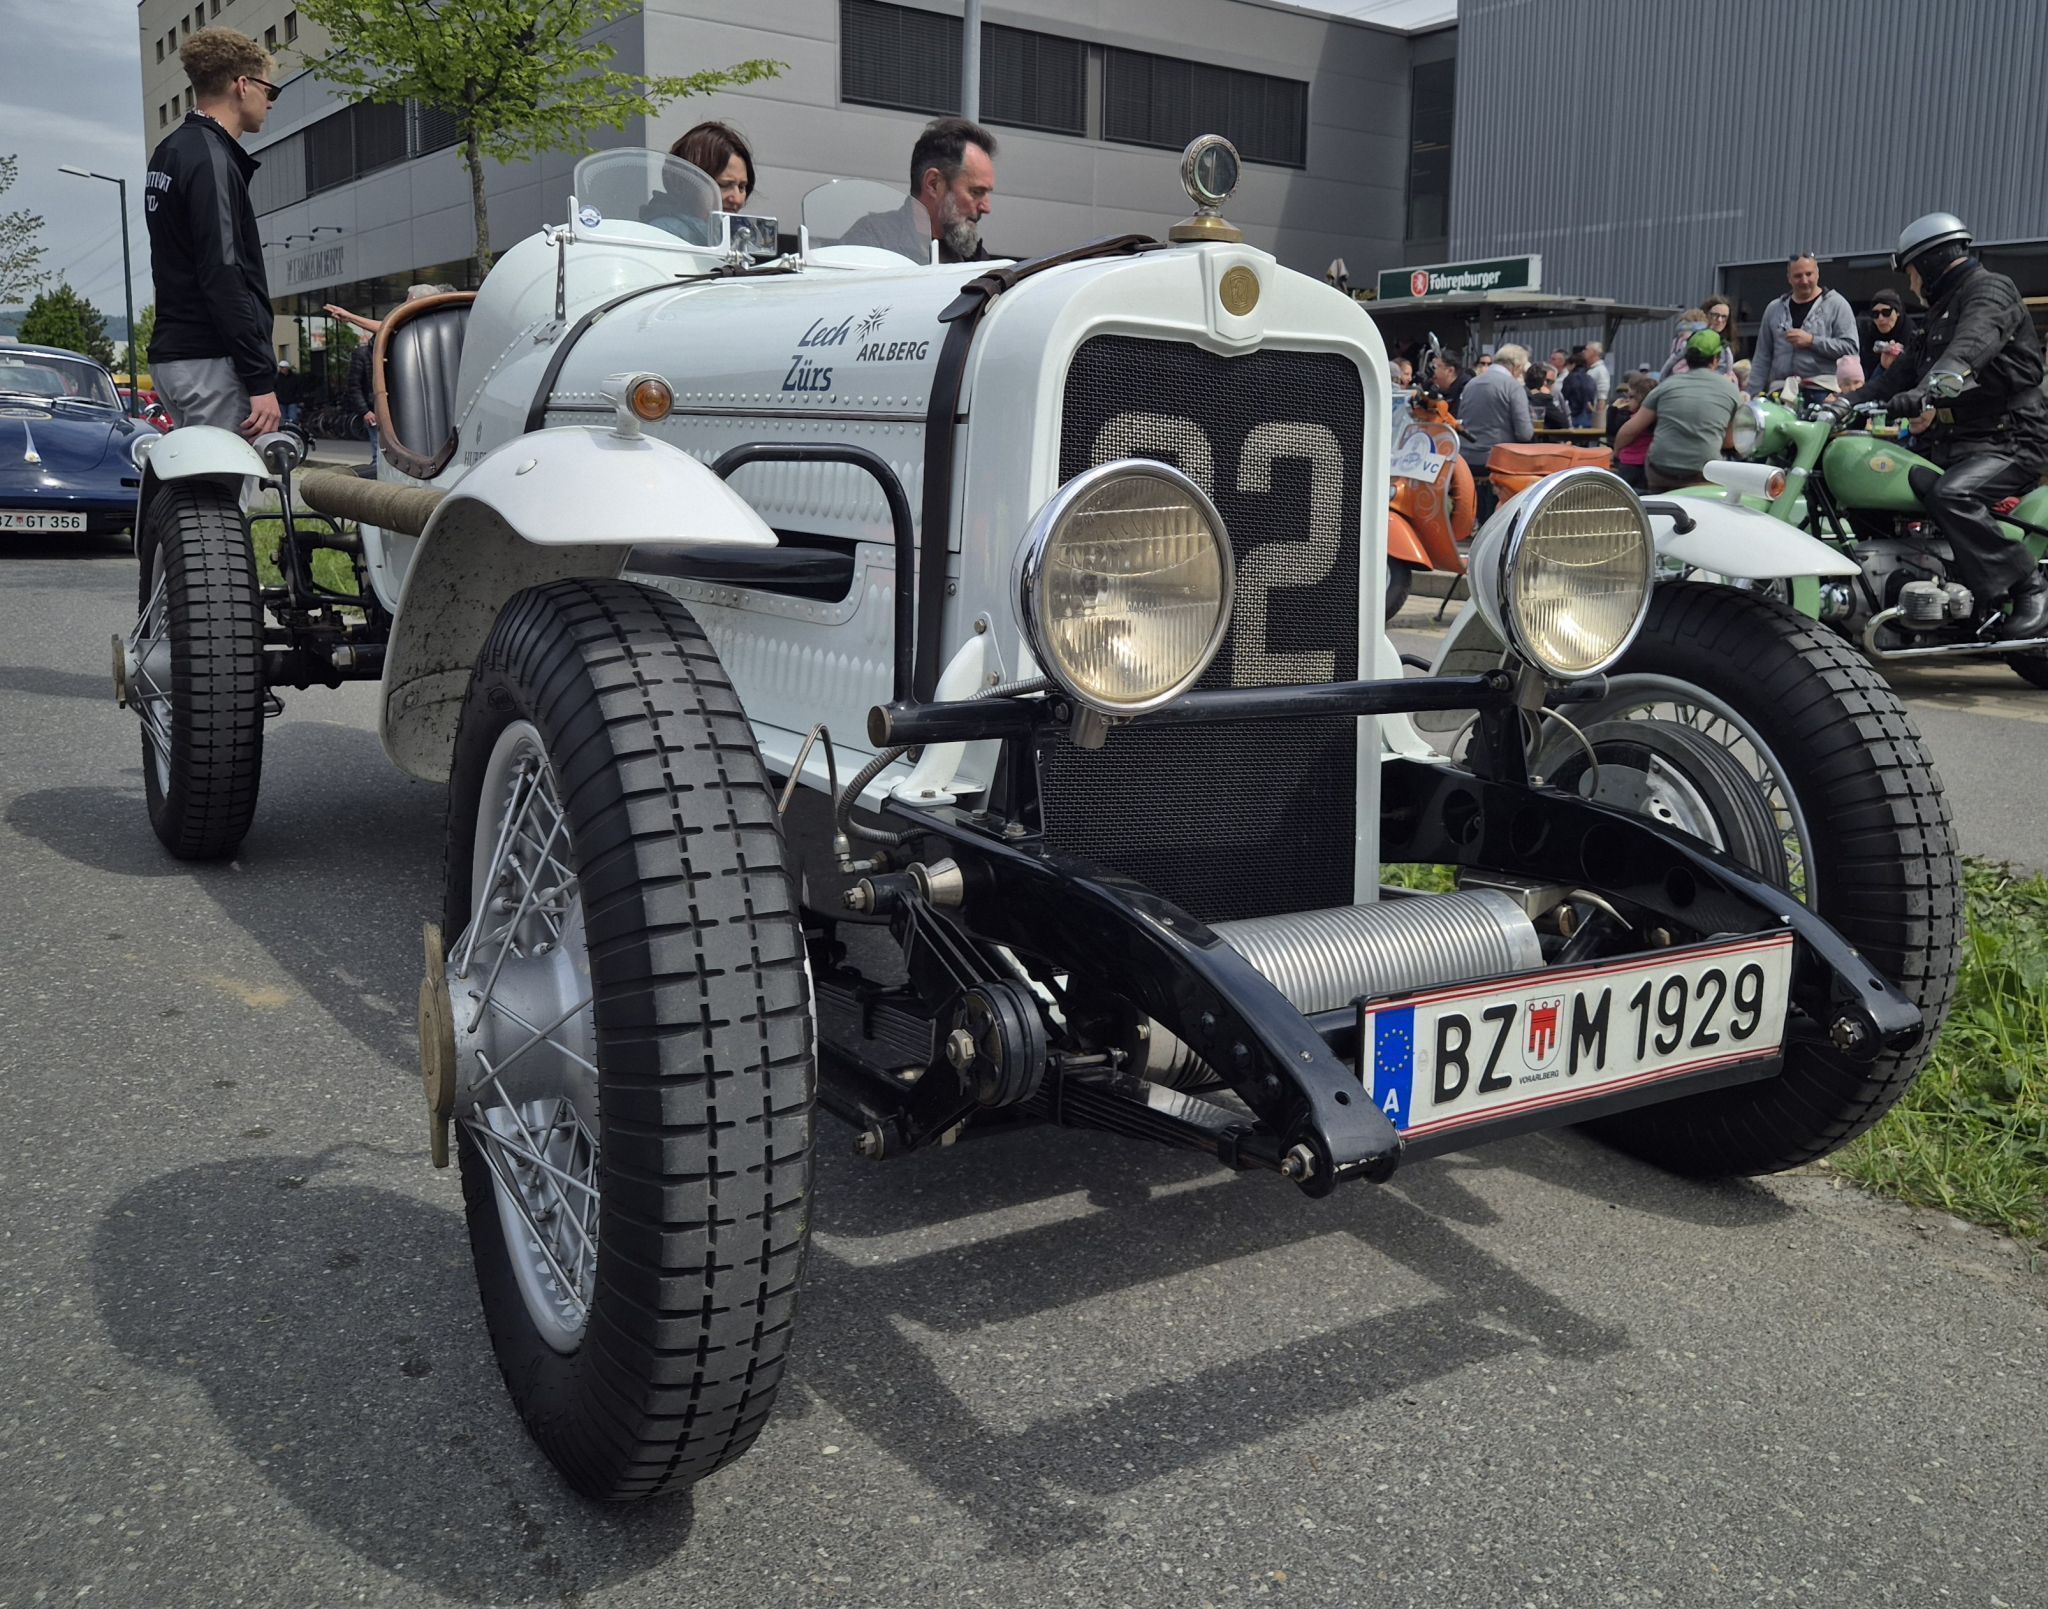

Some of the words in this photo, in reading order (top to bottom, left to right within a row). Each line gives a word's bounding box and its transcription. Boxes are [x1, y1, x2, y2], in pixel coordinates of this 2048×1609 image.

[1429, 269, 1501, 291] Fohrenburger
[797, 315, 855, 347] Lech
[856, 340, 930, 362] ARLBERG
[781, 354, 834, 391] Zürs
[26, 515, 45, 528] GT
[50, 516, 80, 529] 356
[1433, 1003, 1518, 1105] BZ
[1567, 987, 1612, 1076] M
[1629, 962, 1765, 1061] 1929
[1519, 1069, 1560, 1085] VORARLBERG
[1382, 1088, 1400, 1113] A
